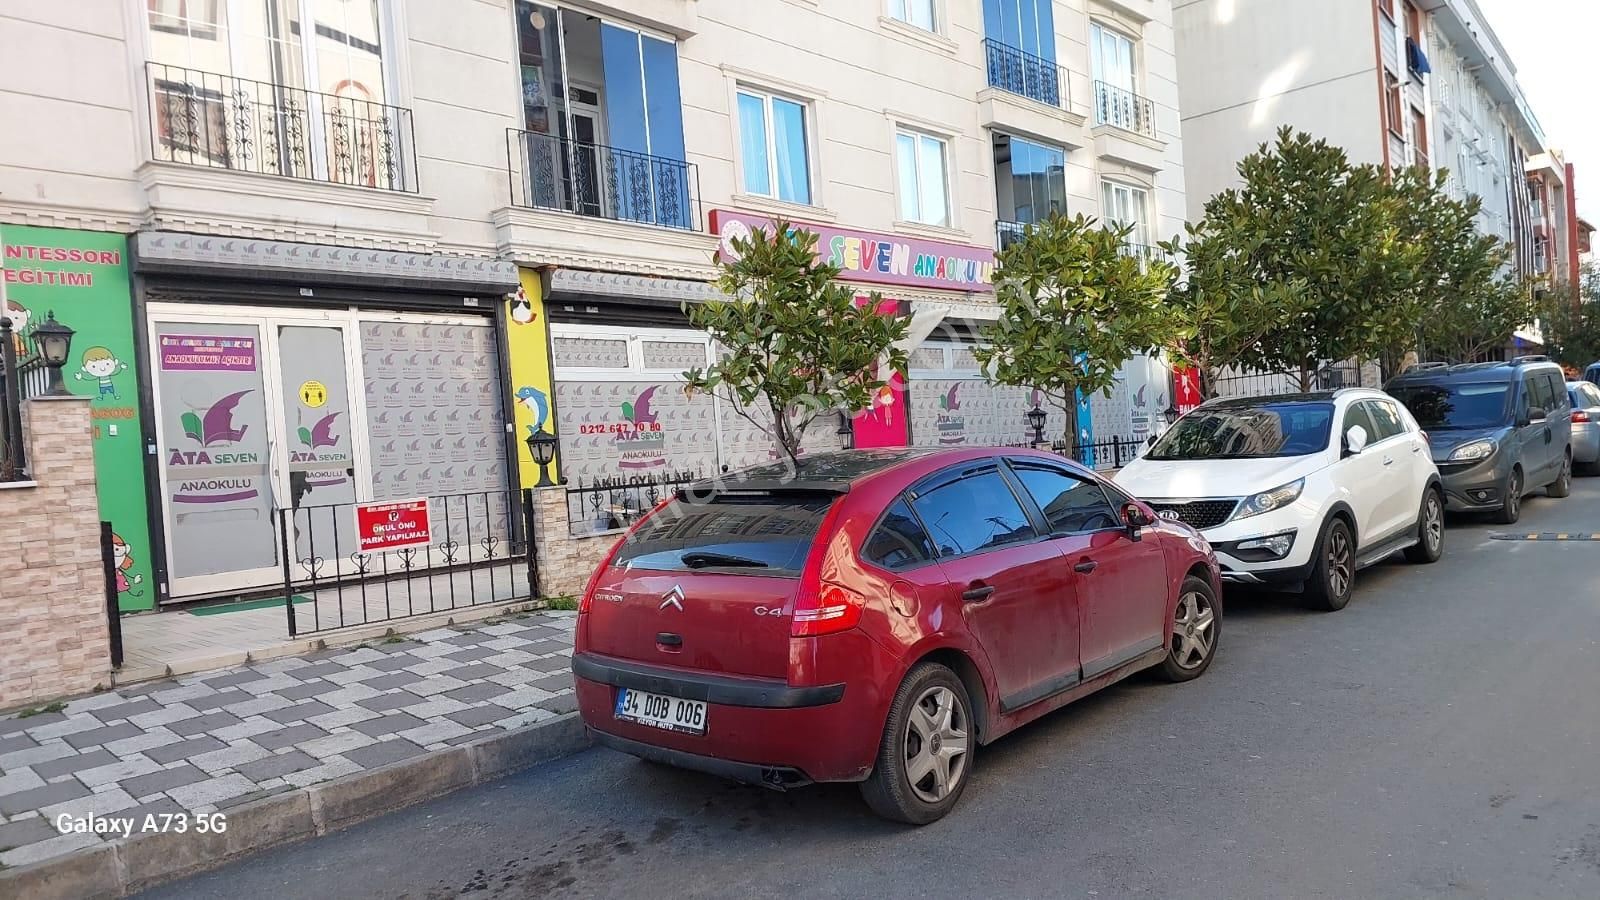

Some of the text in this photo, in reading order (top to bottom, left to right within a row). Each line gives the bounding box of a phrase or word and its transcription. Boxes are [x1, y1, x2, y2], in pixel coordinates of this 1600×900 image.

[5, 245, 121, 265] NTESSORİ
[827, 236, 910, 276] SEVEN
[913, 253, 994, 284] ANAOKULU
[588, 424, 606, 434] 212
[616, 430, 664, 441] ATA SEVEN
[168, 451, 258, 466] ATA SEVEN
[290, 452, 346, 463] ATA SEVEN
[622, 450, 662, 460] ANAOKULU
[179, 479, 251, 492] ANAOKULU
[372, 520, 416, 533] OKUL ÖNÜ
[361, 530, 429, 545] PARK YAPILMAZ.
[754, 606, 783, 618] C4
[623, 691, 703, 726] 34 DOB 006
